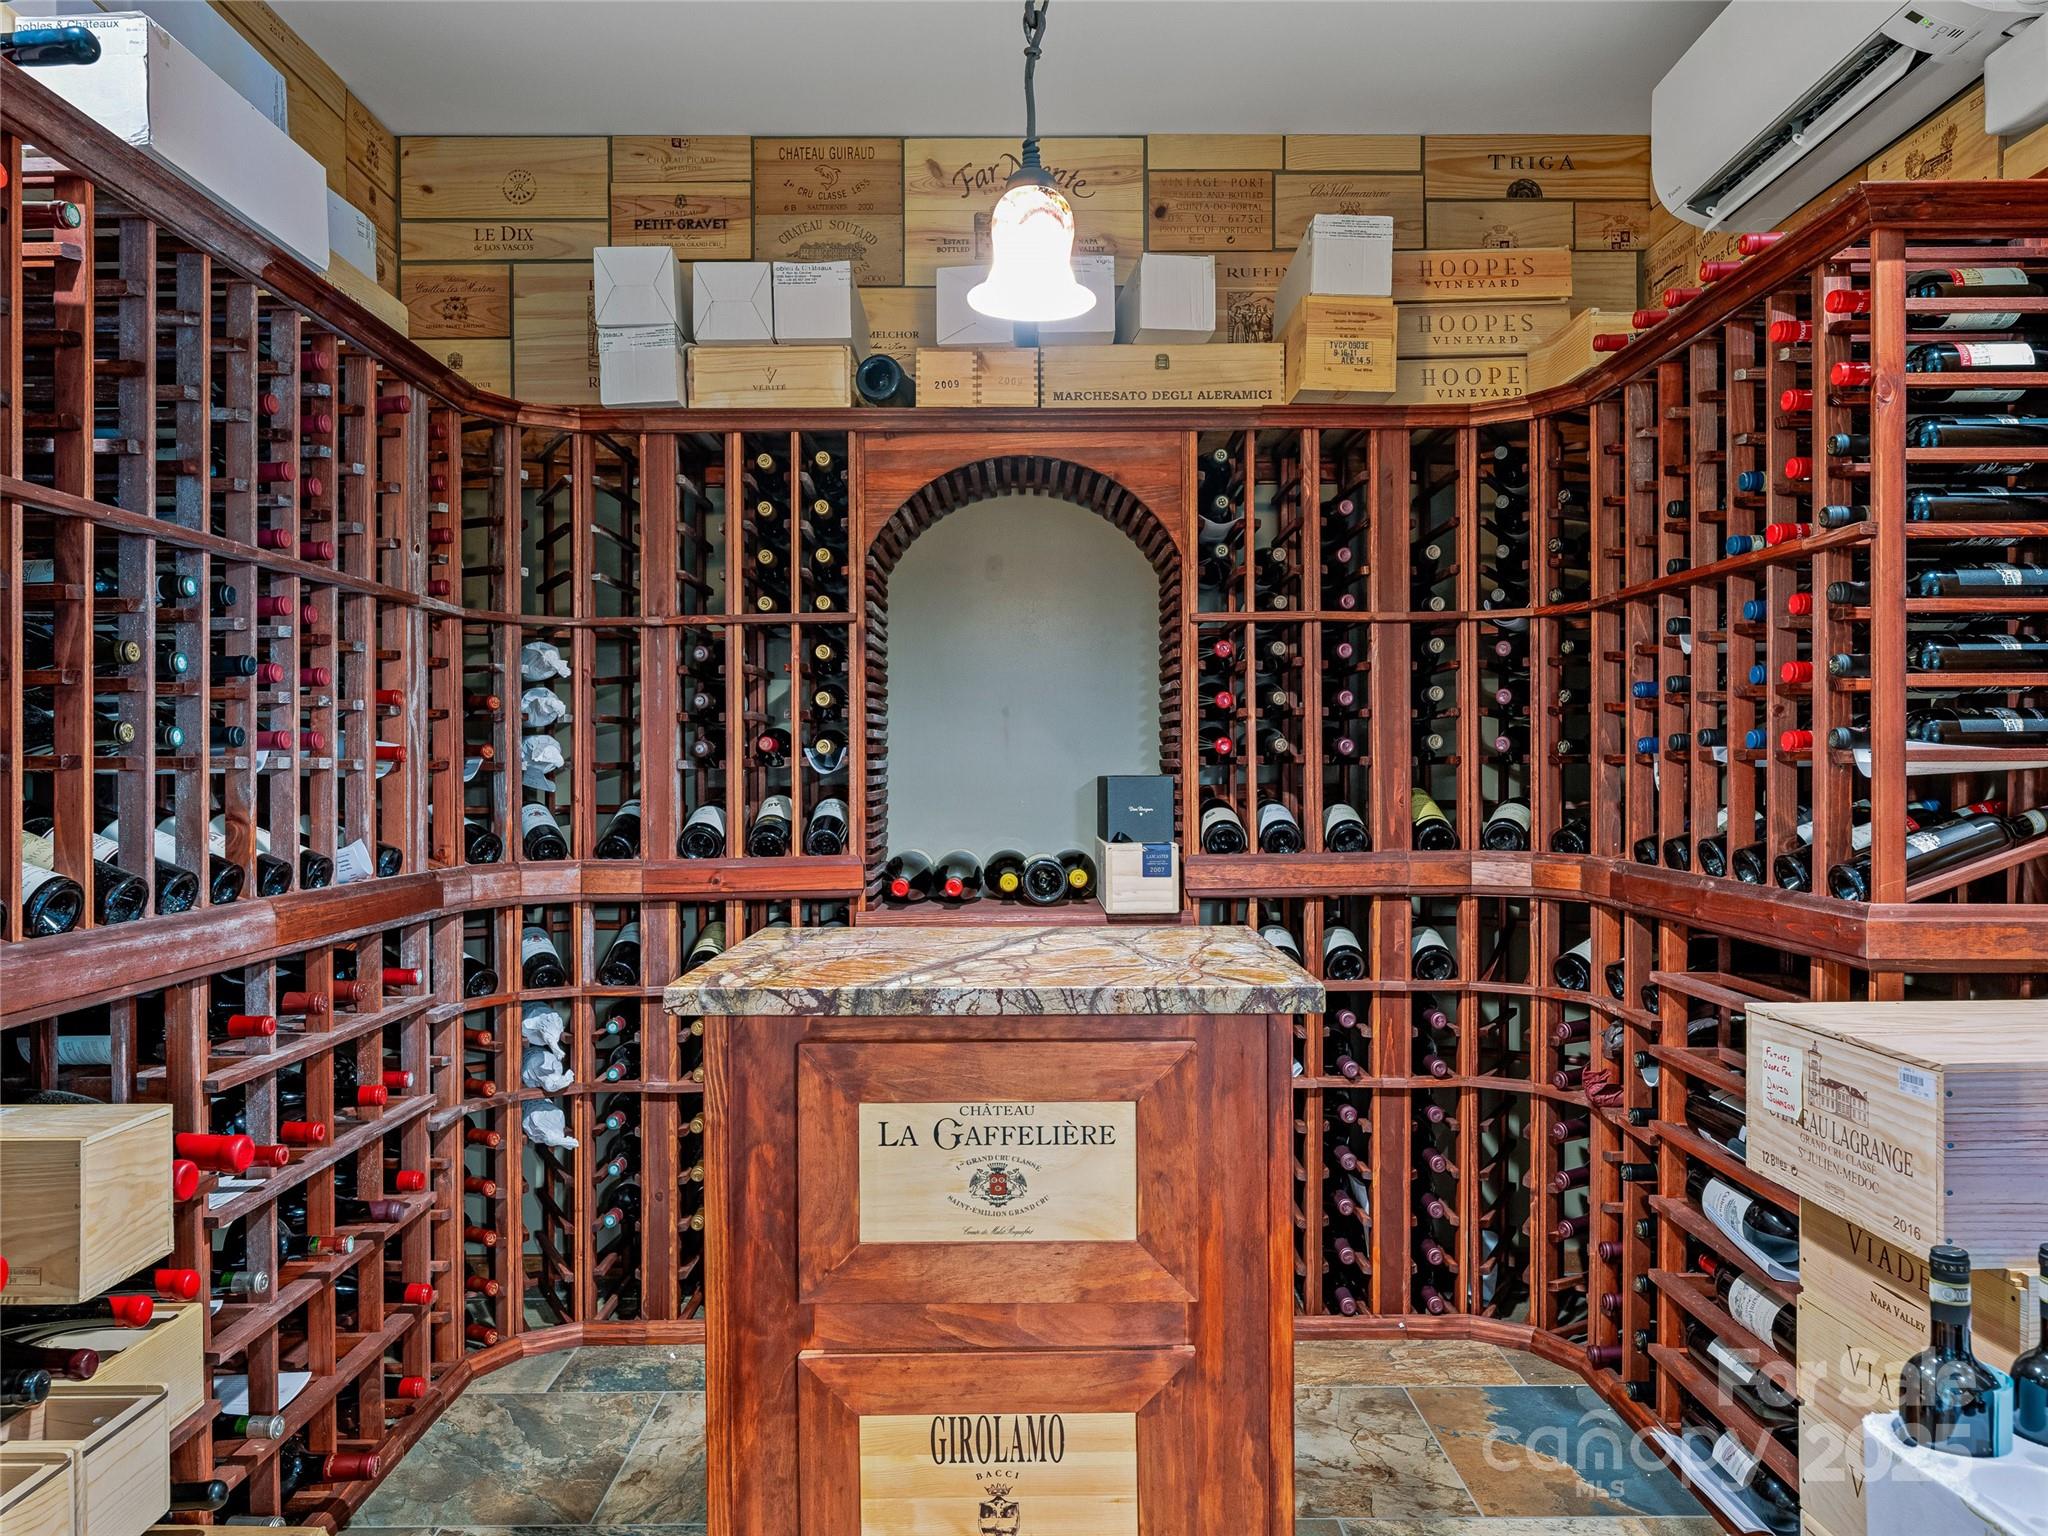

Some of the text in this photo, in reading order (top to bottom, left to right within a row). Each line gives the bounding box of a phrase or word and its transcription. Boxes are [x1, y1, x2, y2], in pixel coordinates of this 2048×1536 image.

[778, 146, 875, 160] CHATEAU GUIRAUD
[1487, 154, 1576, 171] TRIGA
[952, 152, 1096, 199] Far Nente
[1161, 177, 1264, 188] VINTAGE PORT
[797, 186, 813, 199] CRU
[818, 189, 848, 201] CLASSE
[851, 178, 871, 195] 1855
[1206, 191, 1224, 199] AND
[1228, 191, 1264, 199] BOTTLED
[857, 203, 874, 211] 2000
[1231, 203, 1262, 211] PORTAL
[1194, 214, 1217, 223] VOL
[473, 225, 534, 241] LE DIX
[778, 219, 879, 246] CHATEAU SOUTARD
[1221, 225, 1263, 234] PORTUGAL
[943, 238, 970, 246] ESTATE
[1226, 267, 1288, 279] RUFFIN
[1417, 256, 1536, 278] HOOPES
[1434, 279, 1520, 289] VINEYARD
[1417, 313, 1534, 334] HOOPES
[1330, 341, 1347, 350] TVCP
[1432, 336, 1519, 345] VINEYARD
[1421, 366, 1528, 387] HOOPE
[934, 379, 960, 390] 2009
[1052, 389, 1273, 401] MARCHESATO DEGLI ALERAMICI
[1436, 387, 1523, 398] VINEYARD
[1766, 1076, 1789, 1096] DAVID
[959, 1103, 1035, 1117] CHÂTEAU
[878, 1117, 1117, 1151] LA GAFFELIÈRE
[1800, 1132, 1827, 1152] GRAND
[1827, 1145, 1845, 1160] CRU
[1831, 1120, 1914, 1178] LAGRANGE
[966, 1154, 994, 1166] GRAND
[1008, 1203, 1036, 1217] GRAND
[1036, 1194, 1050, 1207] CRU
[1893, 1215, 1922, 1242] 2016
[1846, 1222, 1930, 1295] VIADE
[1870, 1290, 1927, 1334] NAPA VALLEY
[1846, 1343, 1893, 1402] VIA
[930, 1413, 1065, 1465] GIROLAMO
[975, 1469, 1020, 1481] BACCI
